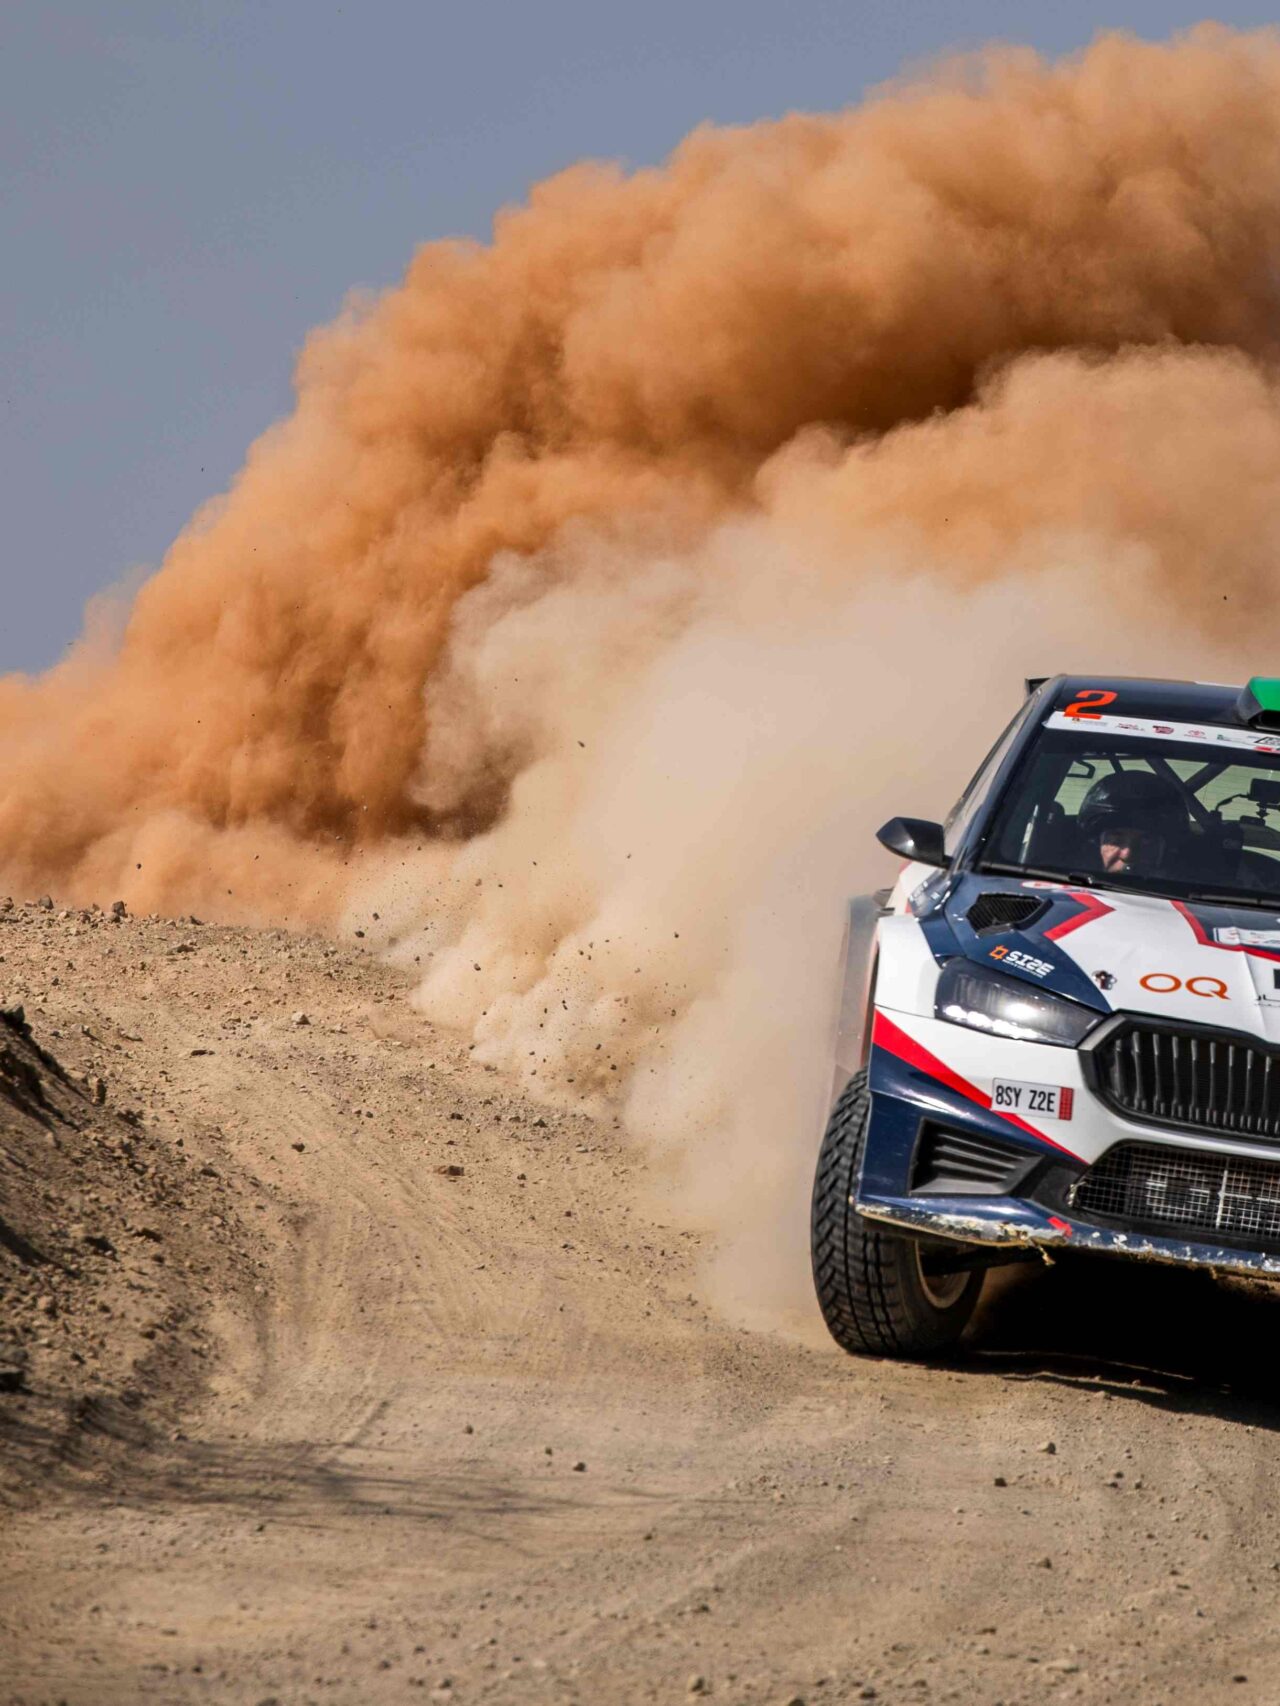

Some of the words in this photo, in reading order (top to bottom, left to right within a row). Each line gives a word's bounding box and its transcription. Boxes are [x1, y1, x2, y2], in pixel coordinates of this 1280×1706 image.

[1064, 689, 1118, 719] 2
[1139, 973, 1231, 1000] OQ
[1028, 1089, 1056, 1112] Z2E
